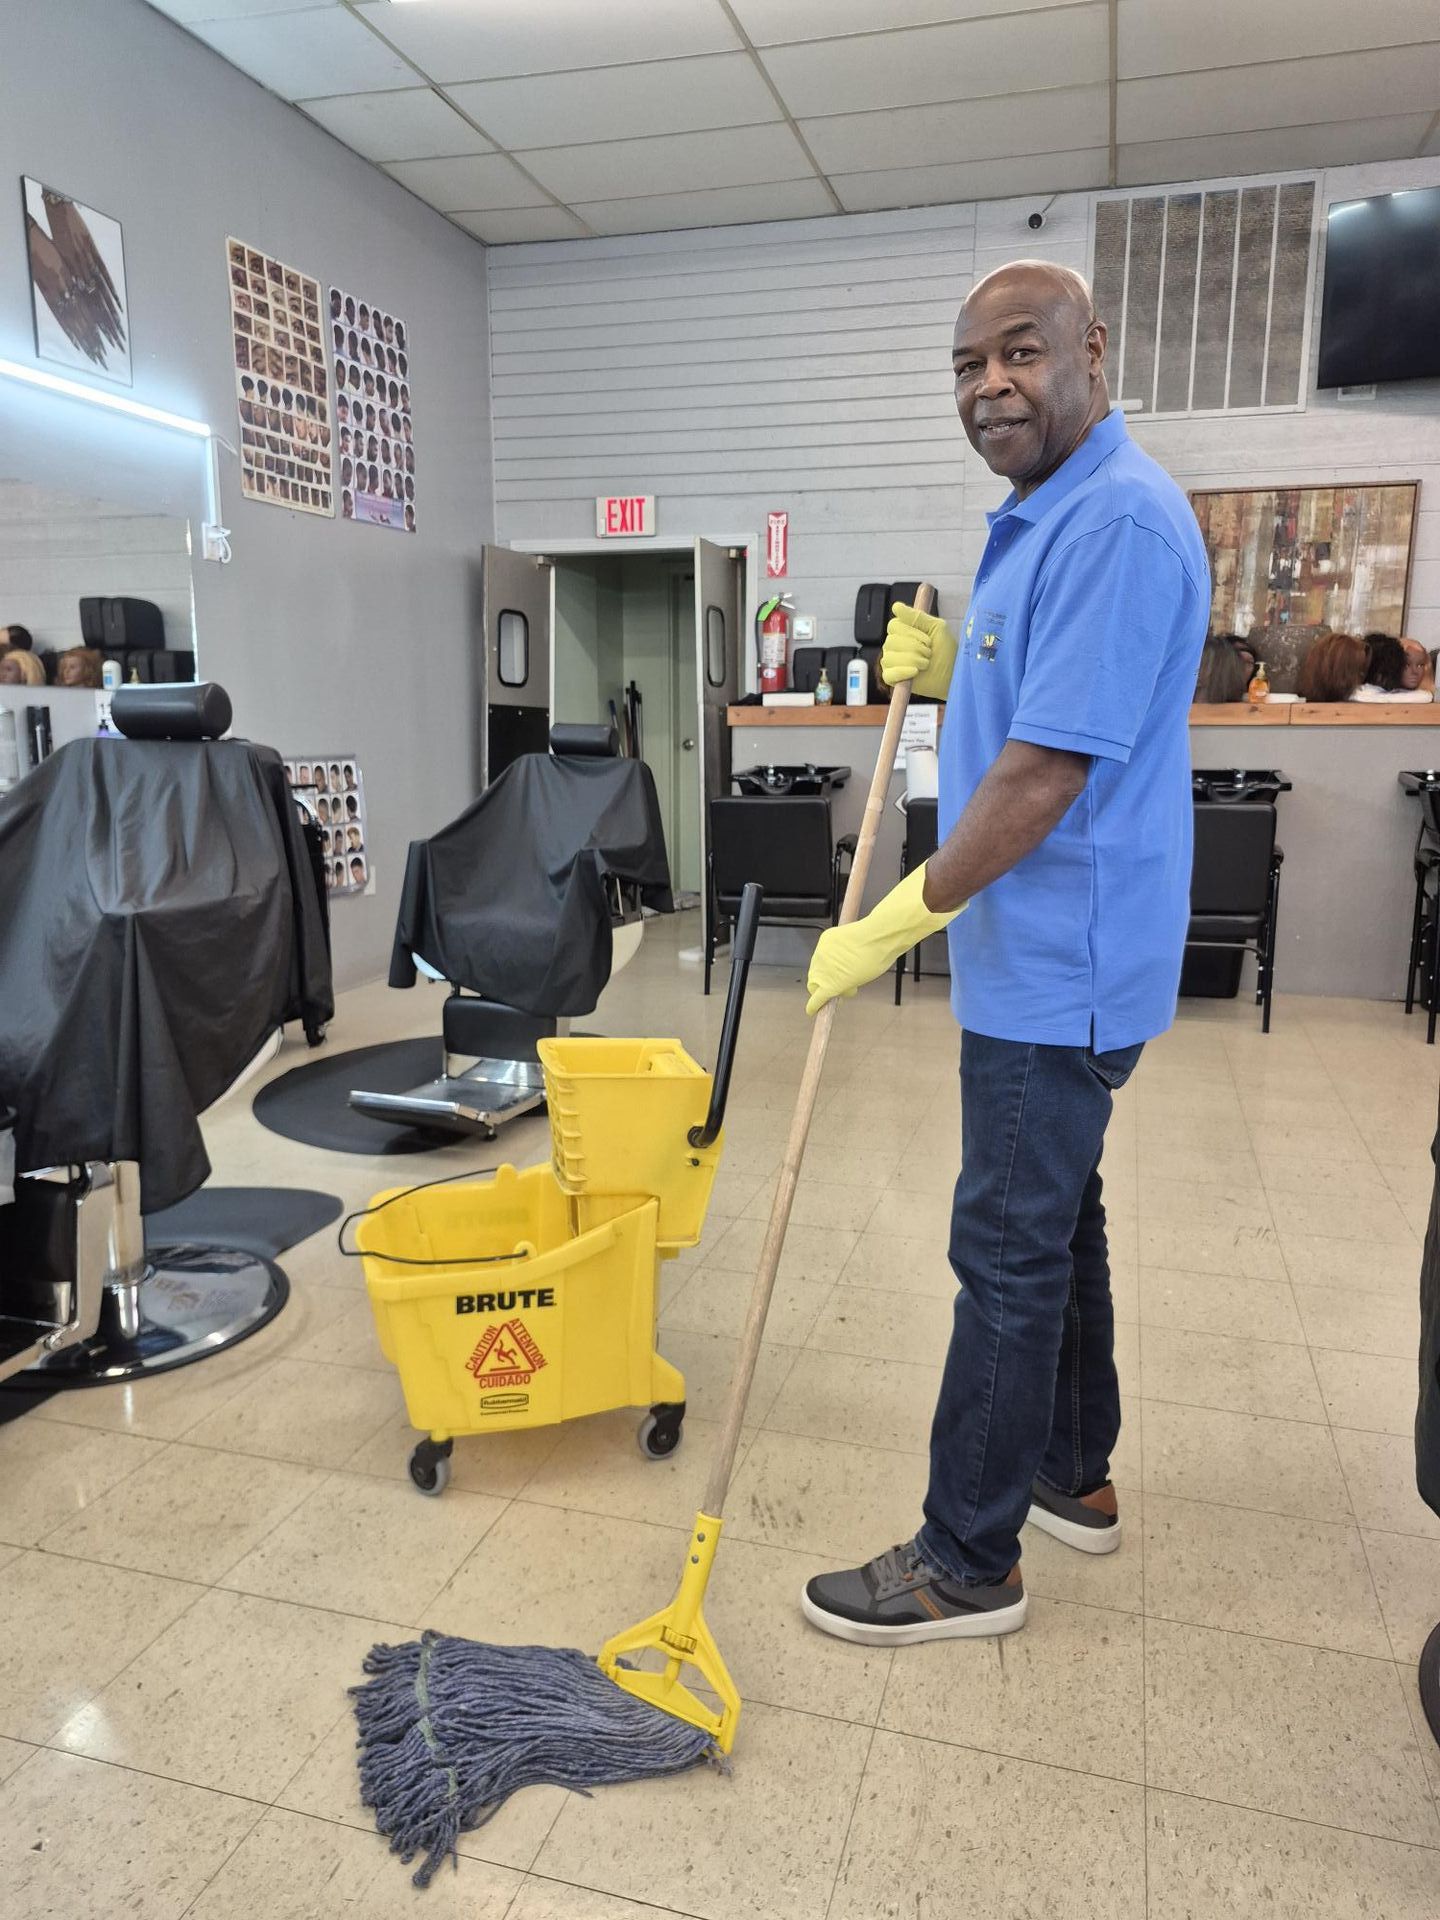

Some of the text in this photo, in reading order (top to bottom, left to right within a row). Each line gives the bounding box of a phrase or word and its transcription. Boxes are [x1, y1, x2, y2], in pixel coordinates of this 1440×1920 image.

[607, 497, 646, 533] EXIT
[456, 1288, 555, 1315] BRUTE
[465, 1325, 498, 1371] CAUTION
[509, 1317, 549, 1370] ATTENTION
[479, 1374, 531, 1389] CUIDADO
